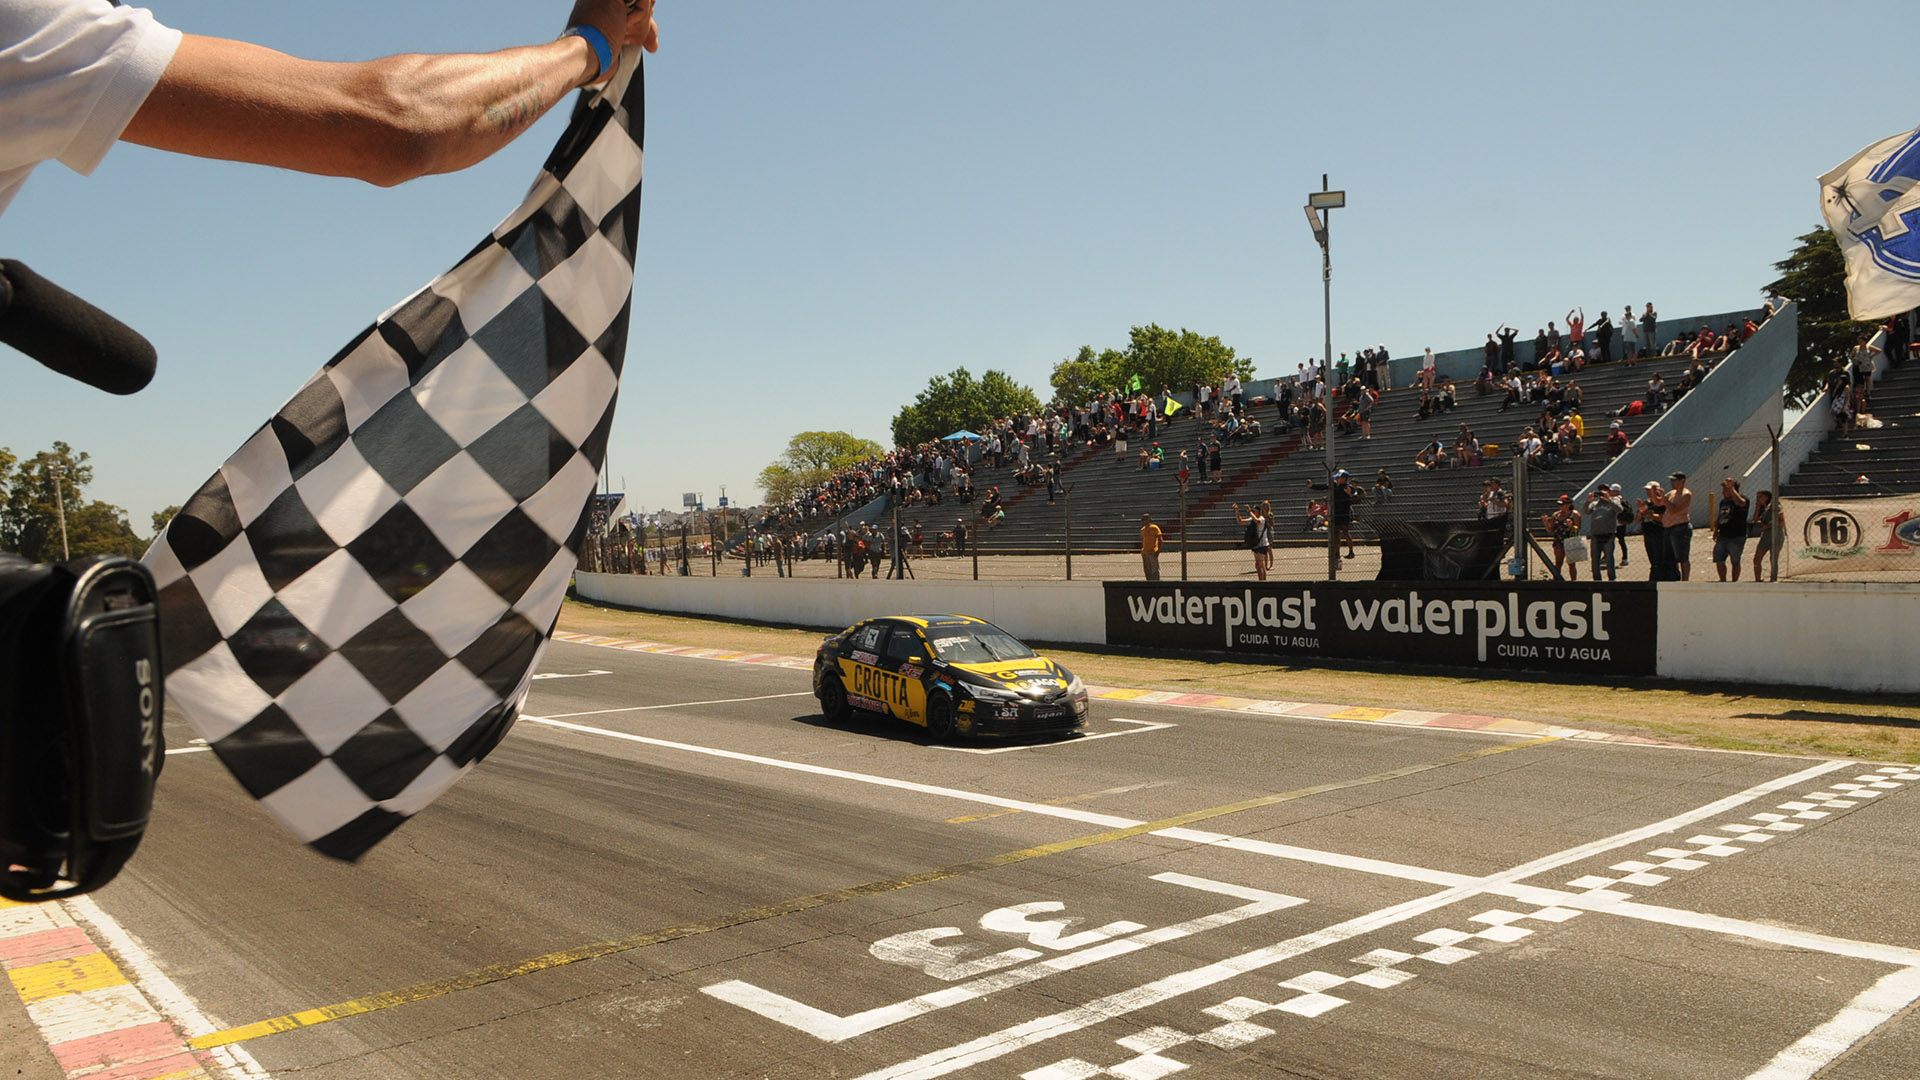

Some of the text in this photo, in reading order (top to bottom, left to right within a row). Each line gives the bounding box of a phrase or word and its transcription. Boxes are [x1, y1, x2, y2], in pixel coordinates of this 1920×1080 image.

[1814, 516, 1848, 544] 16
[1127, 589, 1317, 647] waterplast
[1340, 591, 1611, 662] waterplast
[1240, 633, 1320, 648] CUIDA TU AGUA
[1497, 644, 1612, 661] CUIDA TU AGUA
[855, 664, 909, 708] CROTTA
[1029, 678, 1059, 689] SAGO
[135, 657, 155, 774] SONY
